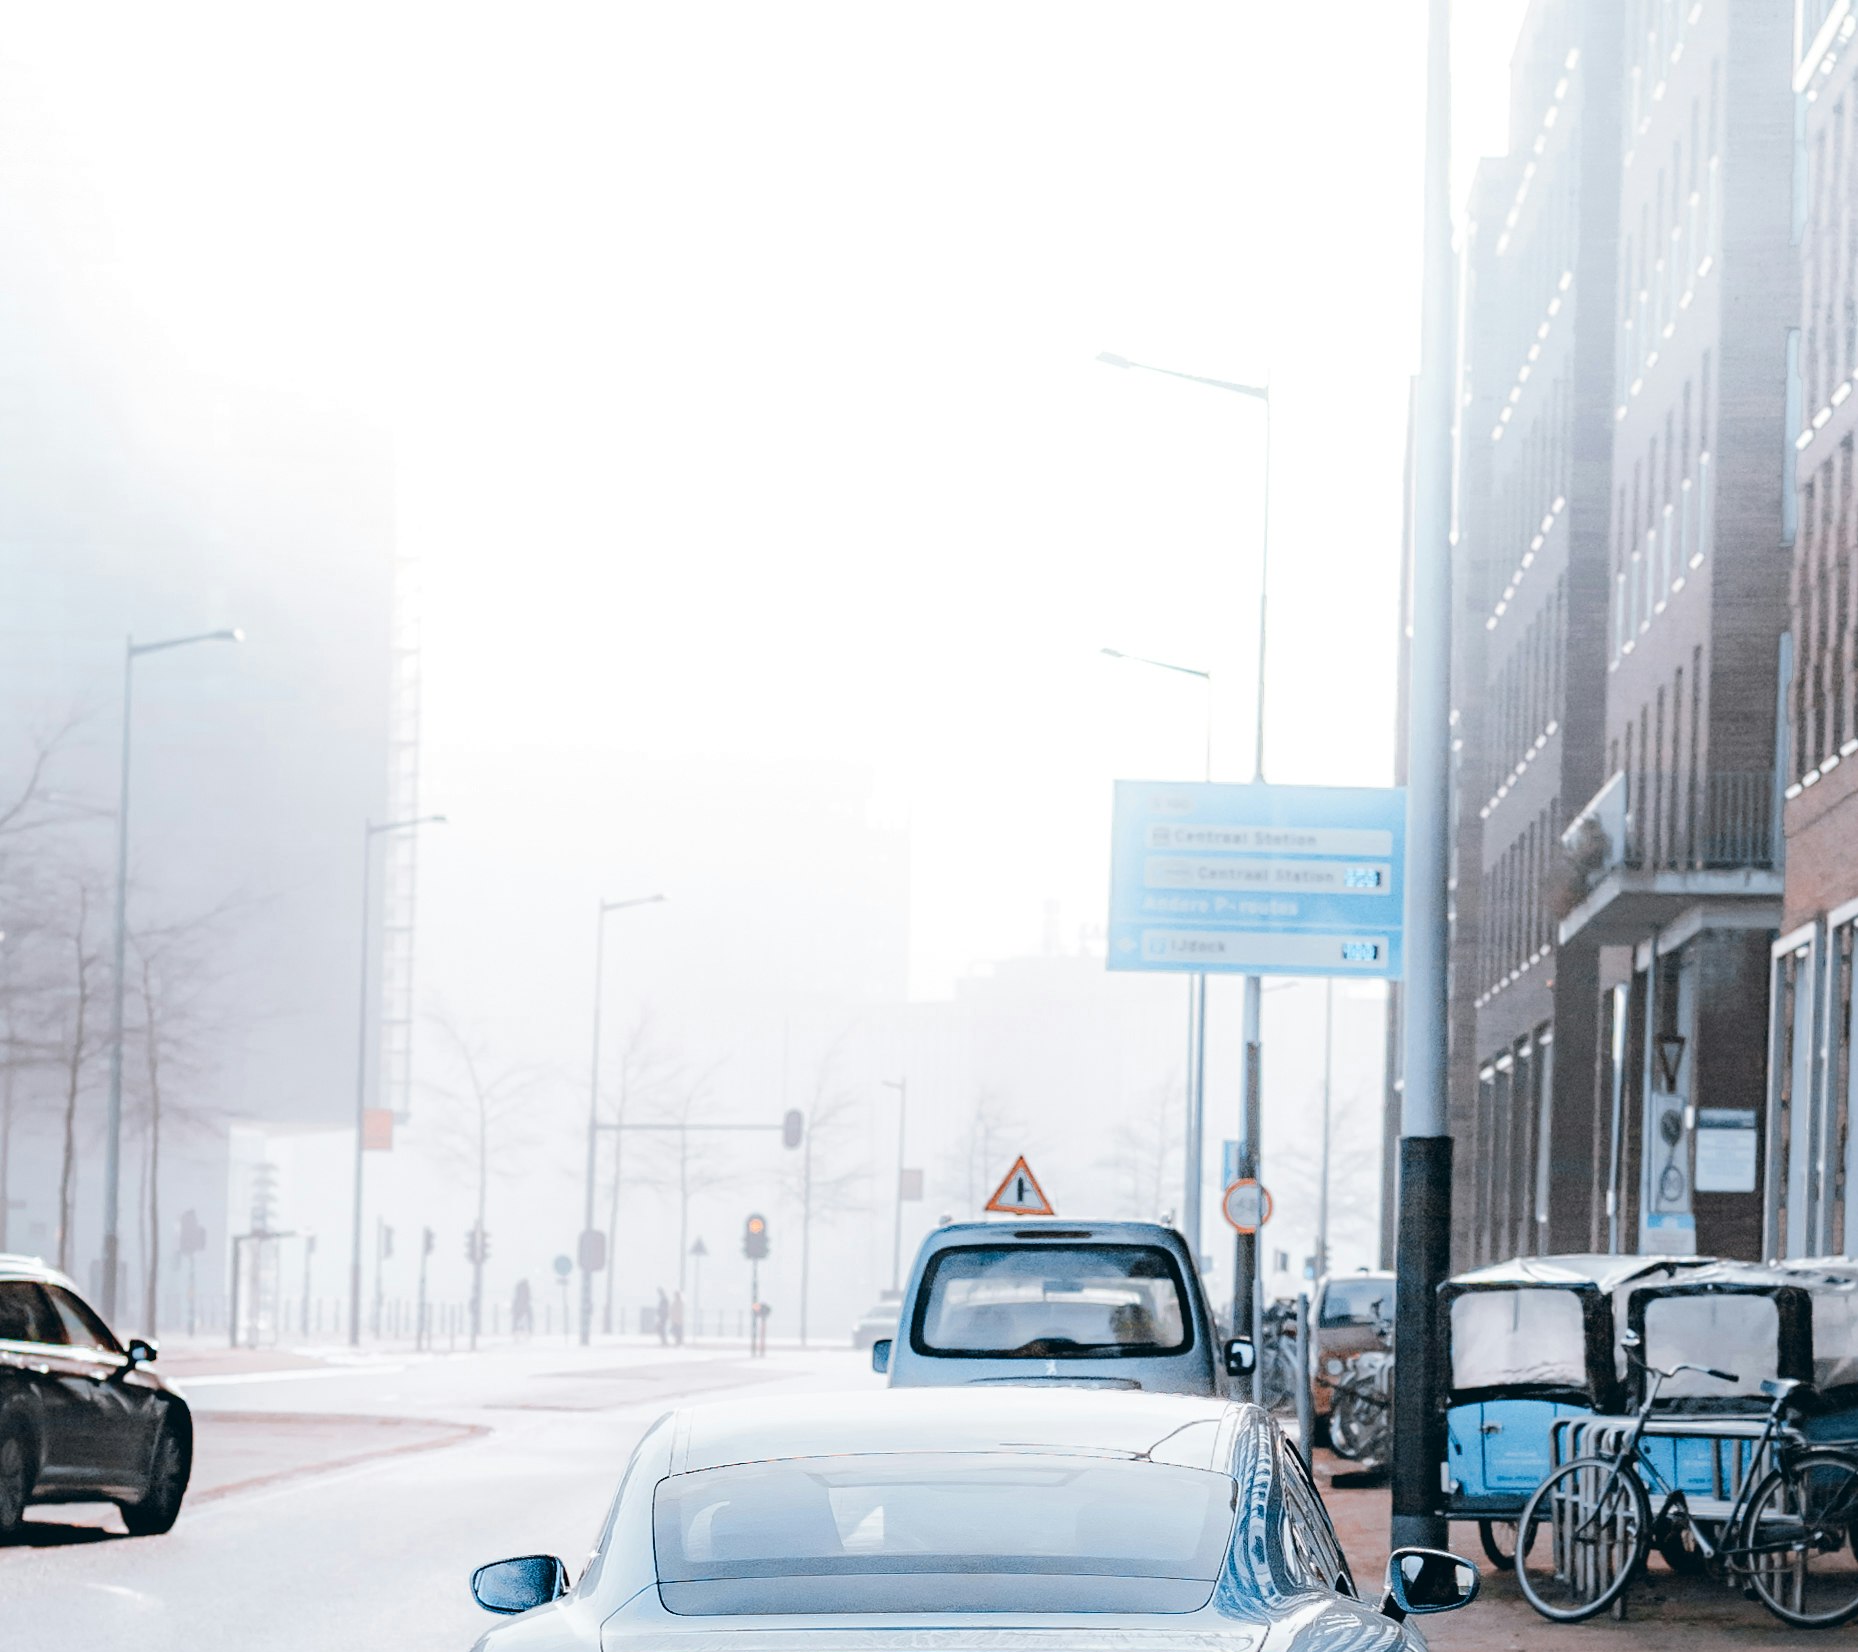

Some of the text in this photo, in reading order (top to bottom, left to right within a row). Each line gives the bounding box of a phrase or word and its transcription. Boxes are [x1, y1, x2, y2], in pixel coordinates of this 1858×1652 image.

[1174, 830, 1318, 846] Centraal Station
[1197, 866, 1269, 881] Centraal
[1275, 868, 1335, 883] Station
